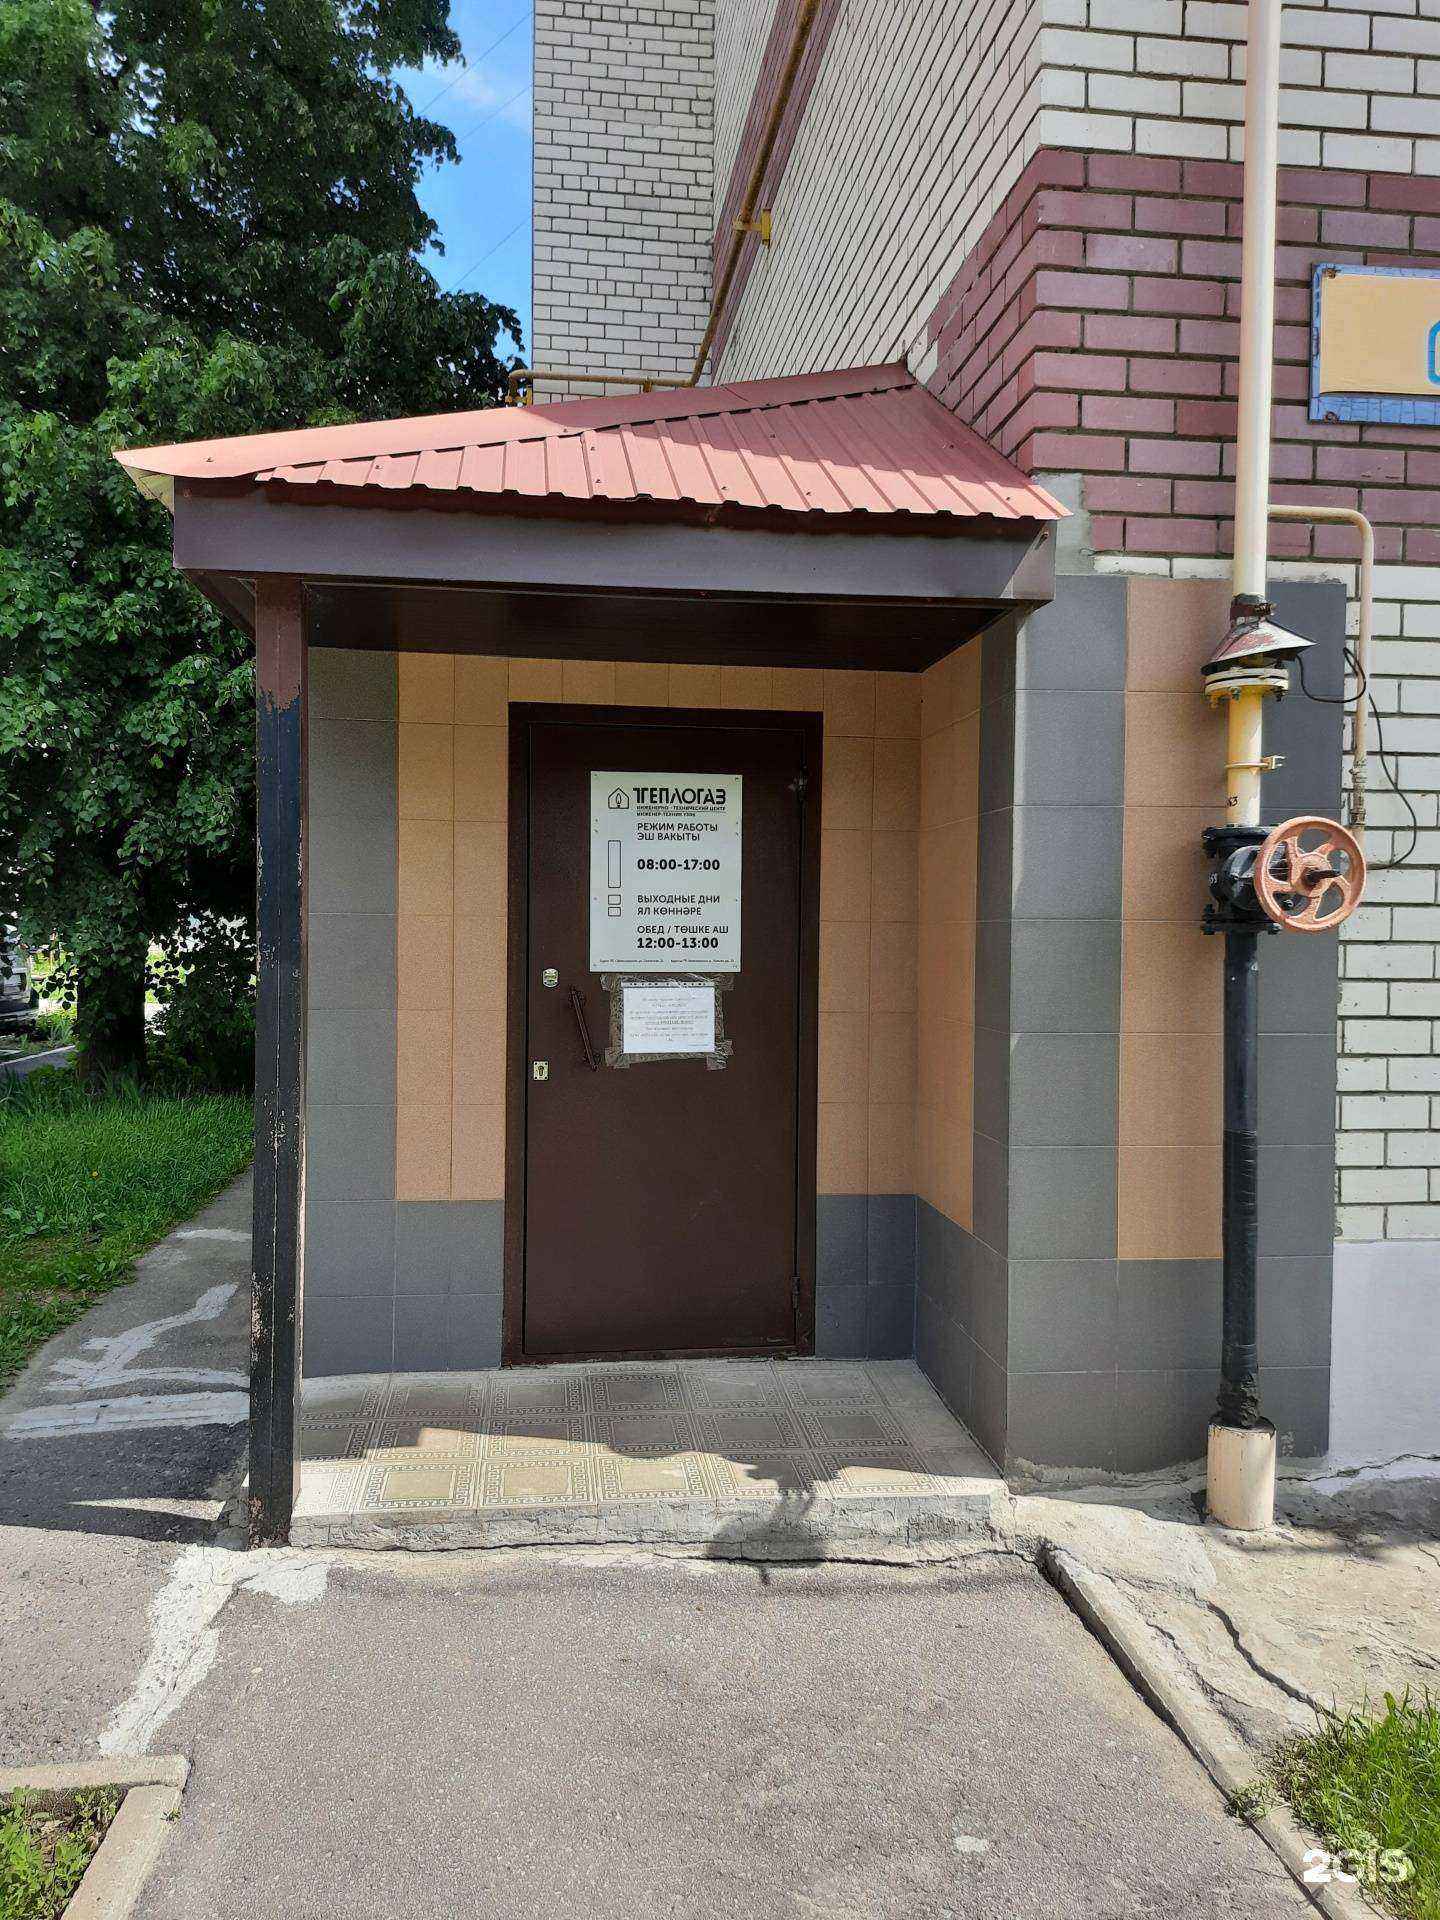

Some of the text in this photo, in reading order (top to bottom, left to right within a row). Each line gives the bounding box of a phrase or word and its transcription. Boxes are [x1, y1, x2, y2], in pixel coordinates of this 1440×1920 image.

[633, 787, 726, 805] ТЕПЛОГАЗ
[637, 822, 718, 832] РЕЖИМ РАБОТЫ
[636, 832, 700, 842] ЭШ ВАКЫТЫ
[637, 858, 720, 871] 08:00-17:00
[637, 894, 720, 905] ВЫХОДНЫЕ ДНИ
[637, 907, 650, 916] ЯЛ
[637, 925, 665, 936] ОБЕД
[712, 925, 729, 936] АШ
[637, 937, 720, 949] 12:00-13:00
